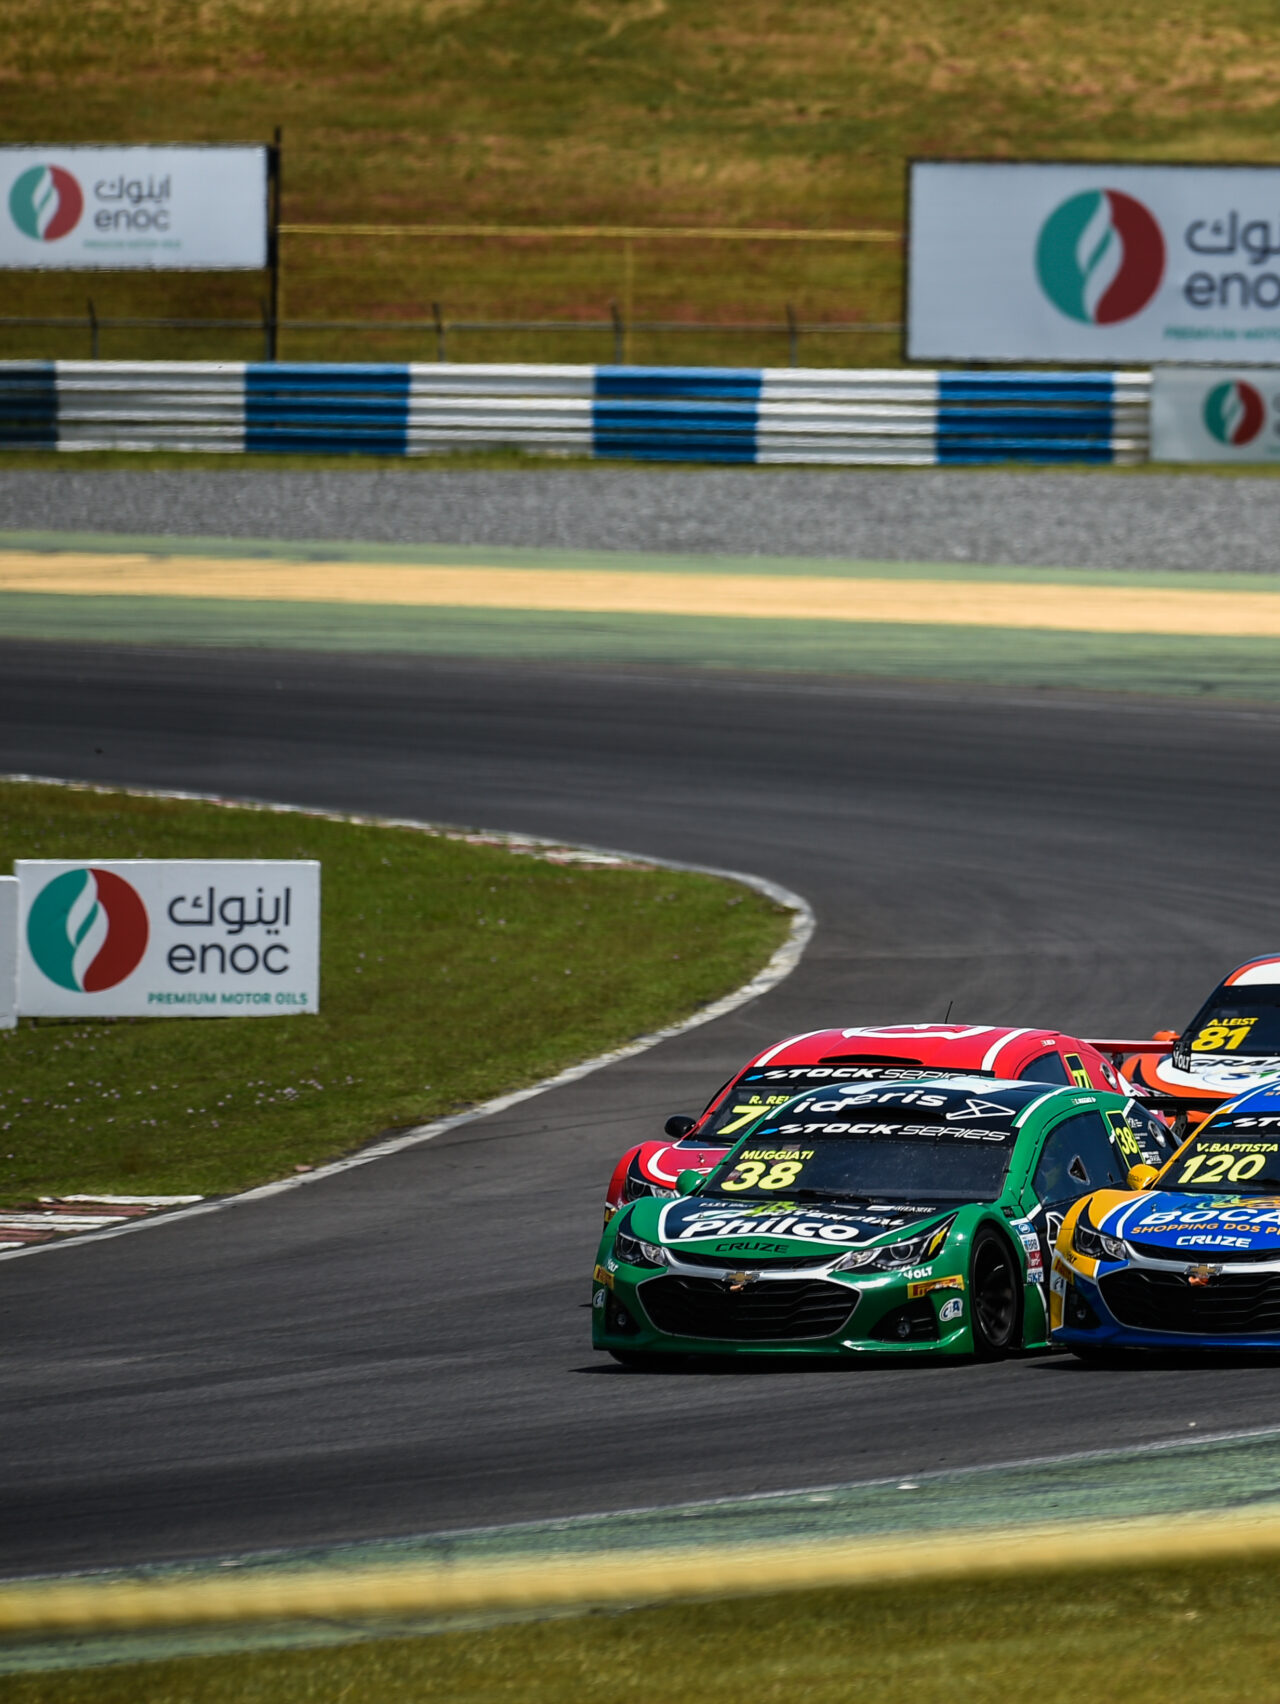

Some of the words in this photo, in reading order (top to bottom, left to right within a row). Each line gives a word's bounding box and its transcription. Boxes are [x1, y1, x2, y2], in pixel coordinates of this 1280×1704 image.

[94, 207, 170, 232] enoc
[168, 887, 291, 935] اينوك
[168, 943, 290, 975] enoc
[148, 992, 217, 1005] PREMIUM
[221, 993, 272, 1005] MOTOR
[275, 993, 308, 1005] OILS
[1207, 1017, 1258, 1027] A.LEIST
[1191, 1026, 1251, 1051] 81
[764, 1067, 884, 1080] STOCK
[749, 1095, 763, 1104] R.
[793, 1090, 948, 1113] ideris
[778, 1123, 905, 1135] STOCK
[898, 1125, 1010, 1141] SERIES
[1115, 1127, 1138, 1155] 38
[1196, 1143, 1279, 1153] V.BAPTISTA
[739, 1151, 815, 1160] MUGGIATI
[721, 1161, 804, 1191] 38
[1177, 1154, 1266, 1184] 120
[679, 1217, 860, 1240] Philco
[1130, 1223, 1218, 1234] SHOPPING
[1223, 1223, 1261, 1233] DOS
[715, 1242, 790, 1253] CRUZE
[1176, 1235, 1252, 1248] CRUZE
[903, 1266, 933, 1280] VOLT
